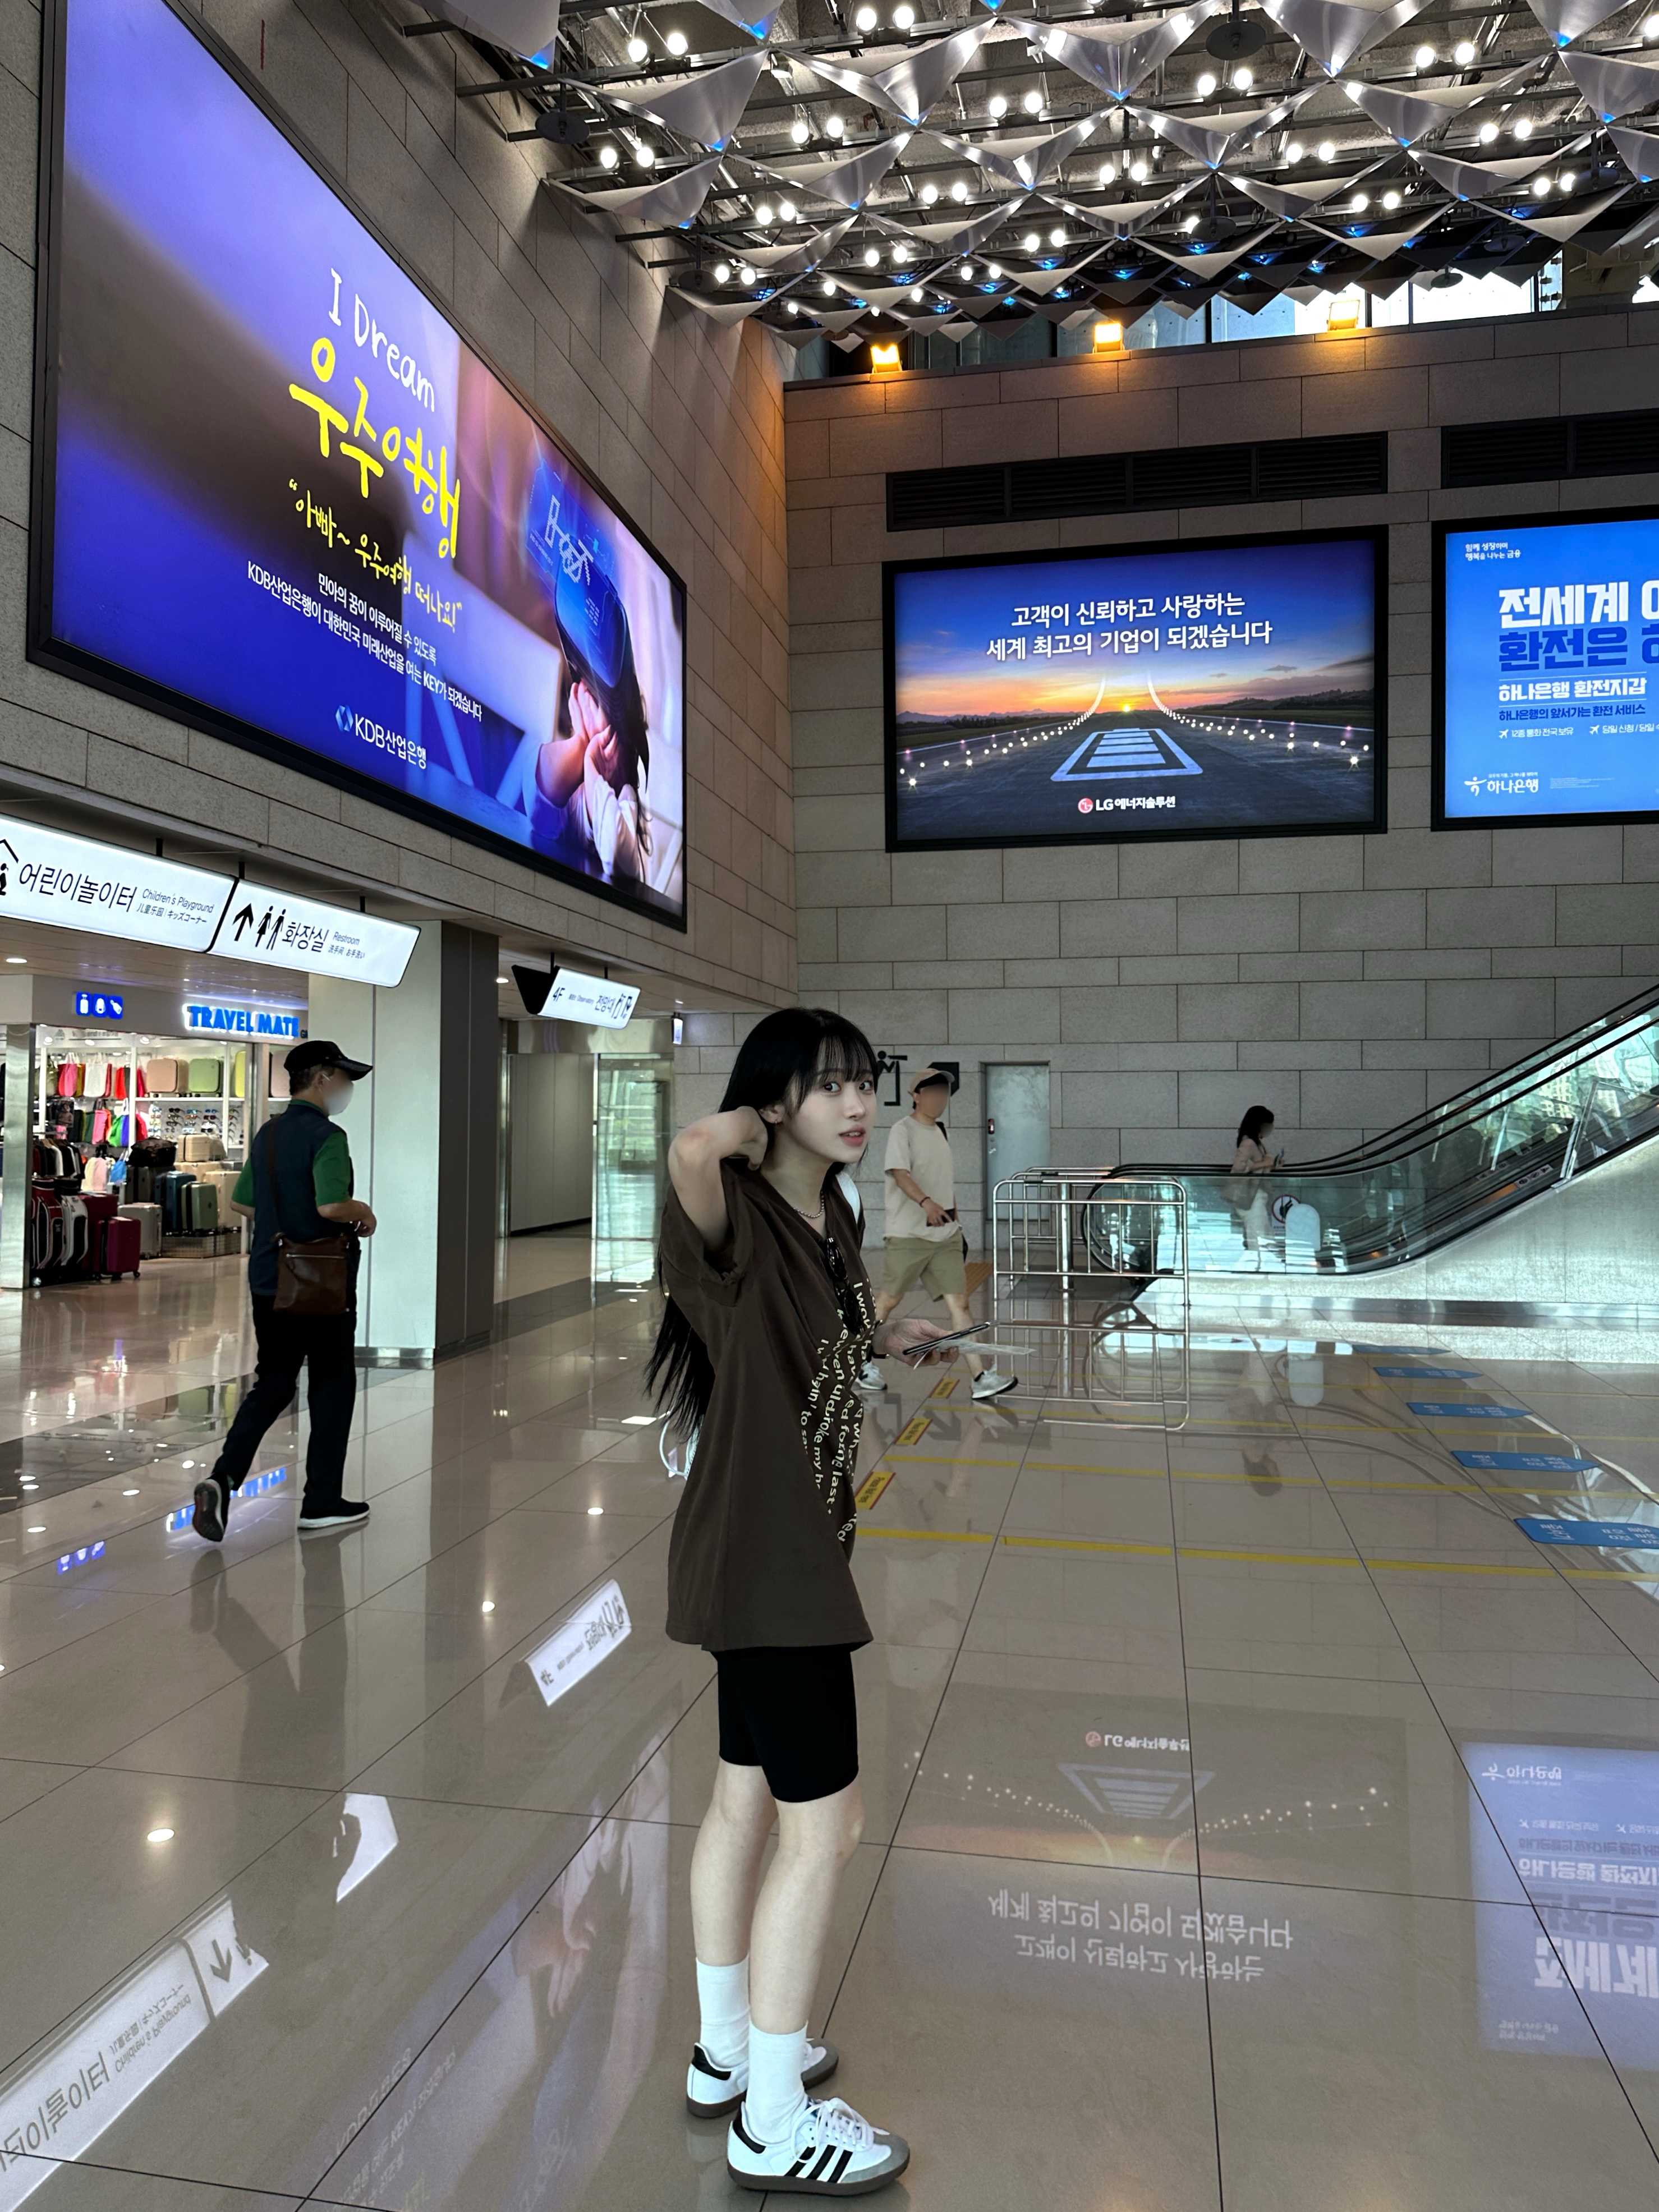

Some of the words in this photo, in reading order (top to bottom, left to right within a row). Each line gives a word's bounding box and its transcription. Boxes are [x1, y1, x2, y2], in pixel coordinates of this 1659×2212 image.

[330, 267, 342, 326] I
[354, 293, 435, 413] Dream
[289, 337, 459, 558] 우주여행
[355, 534, 412, 595] 우주여행
[319, 573, 347, 609] 민아의
[348, 592, 367, 622] 꿈이
[369, 606, 403, 645] 이루어질
[404, 630, 413, 649] 수
[414, 636, 437, 666] 있도록
[1011, 603, 1069, 628] 고객이
[1076, 598, 1156, 625] 신뢰하고
[1160, 592, 1245, 619] 사랑하는
[1499, 581, 1629, 629] 전세계
[248, 561, 321, 624] KDB산업은행이
[324, 609, 361, 648] 대한민국
[362, 633, 405, 674] 미래산업을
[406, 660, 422, 686] 여는
[423, 670, 447, 700] KEY가
[448, 686, 482, 723] 되겠습니다
[986, 636, 1026, 661] 세계
[1033, 632, 1092, 658] 최고의
[1100, 627, 1159, 654] 기업이
[1167, 620, 1273, 650] 되겠습니다
[1499, 626, 1628, 672] 환전은
[1499, 681, 1570, 702] 하나은행
[1574, 677, 1647, 698] 환전지갑
[1499, 709, 1548, 721] 하나은행의
[1550, 706, 1591, 719] 앞서가는
[1592, 705, 1613, 716] 환전
[1615, 704, 1646, 716] 서비스
[355, 713, 426, 770] KDB산업은행
[1526, 729, 1542, 738] 통화
[1542, 728, 1557, 737] 전국
[1559, 726, 1574, 736] 보유
[1602, 725, 1617, 734] 당일
[1619, 724, 1634, 733] 신청
[1639, 723, 1655, 732] 당일
[1487, 779, 1538, 794] 하나은행
[19, 864, 137, 913] 어린이놀이터
[143, 889, 176, 905] Children's
[177, 897, 214, 914] Playground
[136, 903, 164, 918] 儿童乐园
[167, 910, 208, 925] キッズコーナー
[282, 922, 329, 953] 화장실
[333, 931, 360, 946] Restroom
[552, 986, 566, 1002] 4F
[189, 1005, 255, 1033] TRAVEL
[258, 1011, 299, 1037] MATE
[801, 1411, 812, 1425] to
[814, 1447, 822, 1470] my
